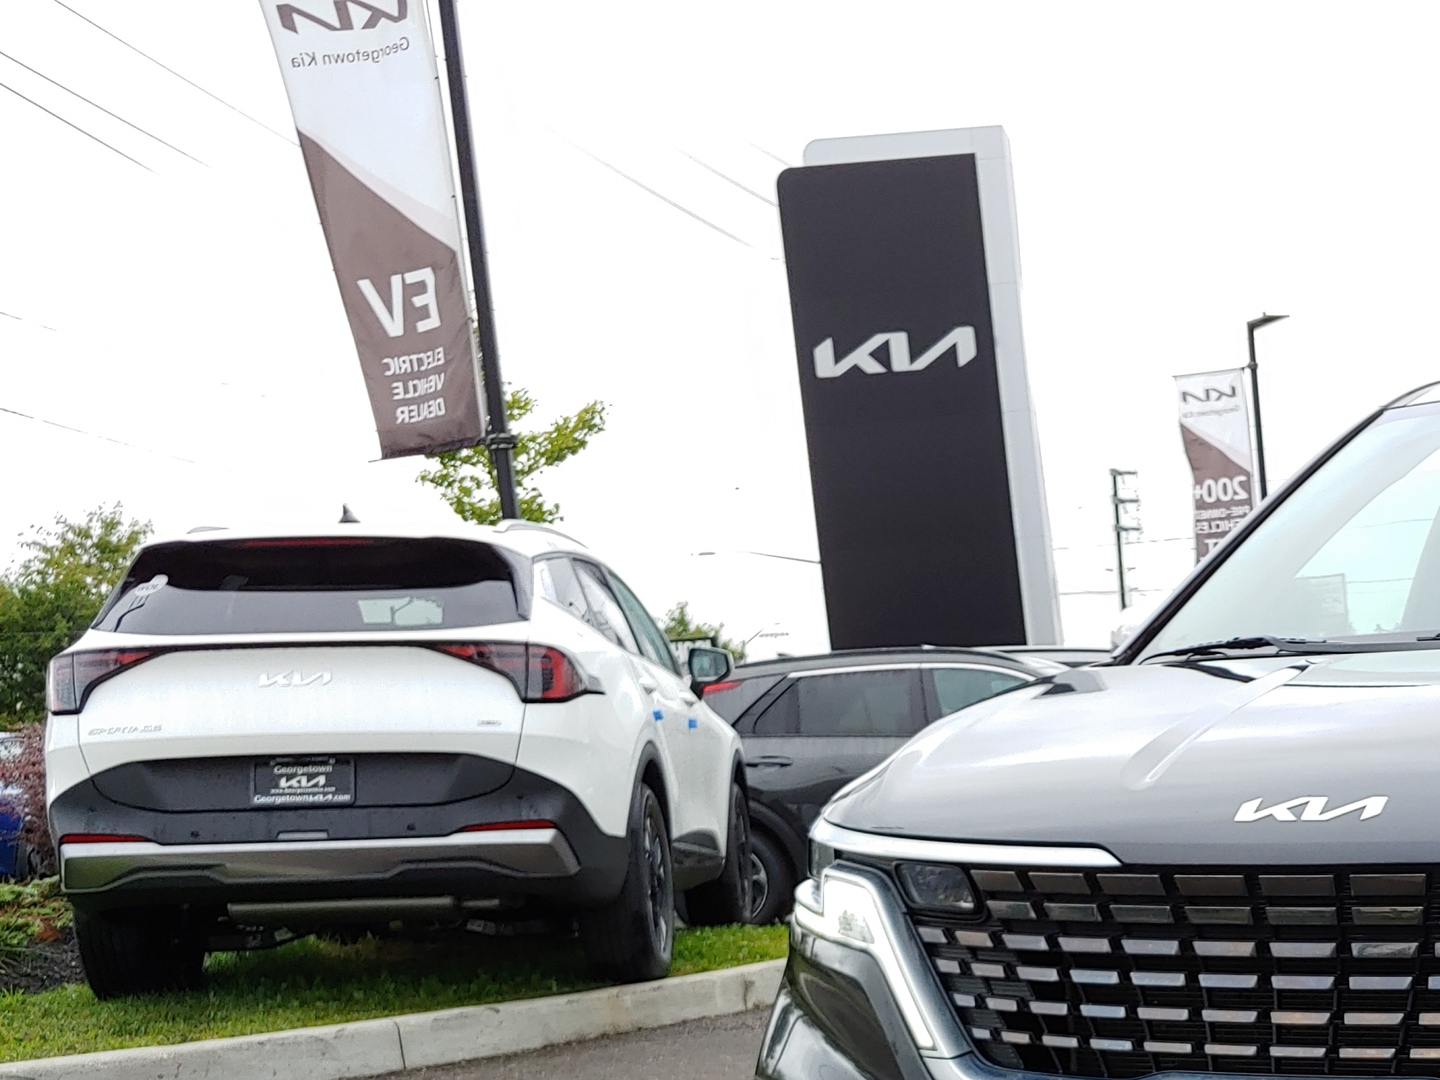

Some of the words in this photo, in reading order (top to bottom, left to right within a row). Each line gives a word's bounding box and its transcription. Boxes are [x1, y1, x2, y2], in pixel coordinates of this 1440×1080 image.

[813, 325, 977, 378] KIA
[257, 669, 333, 688] KIA
[273, 764, 333, 775] Georgetown
[279, 774, 326, 788] KIA
[1233, 796, 1389, 822] KIA
